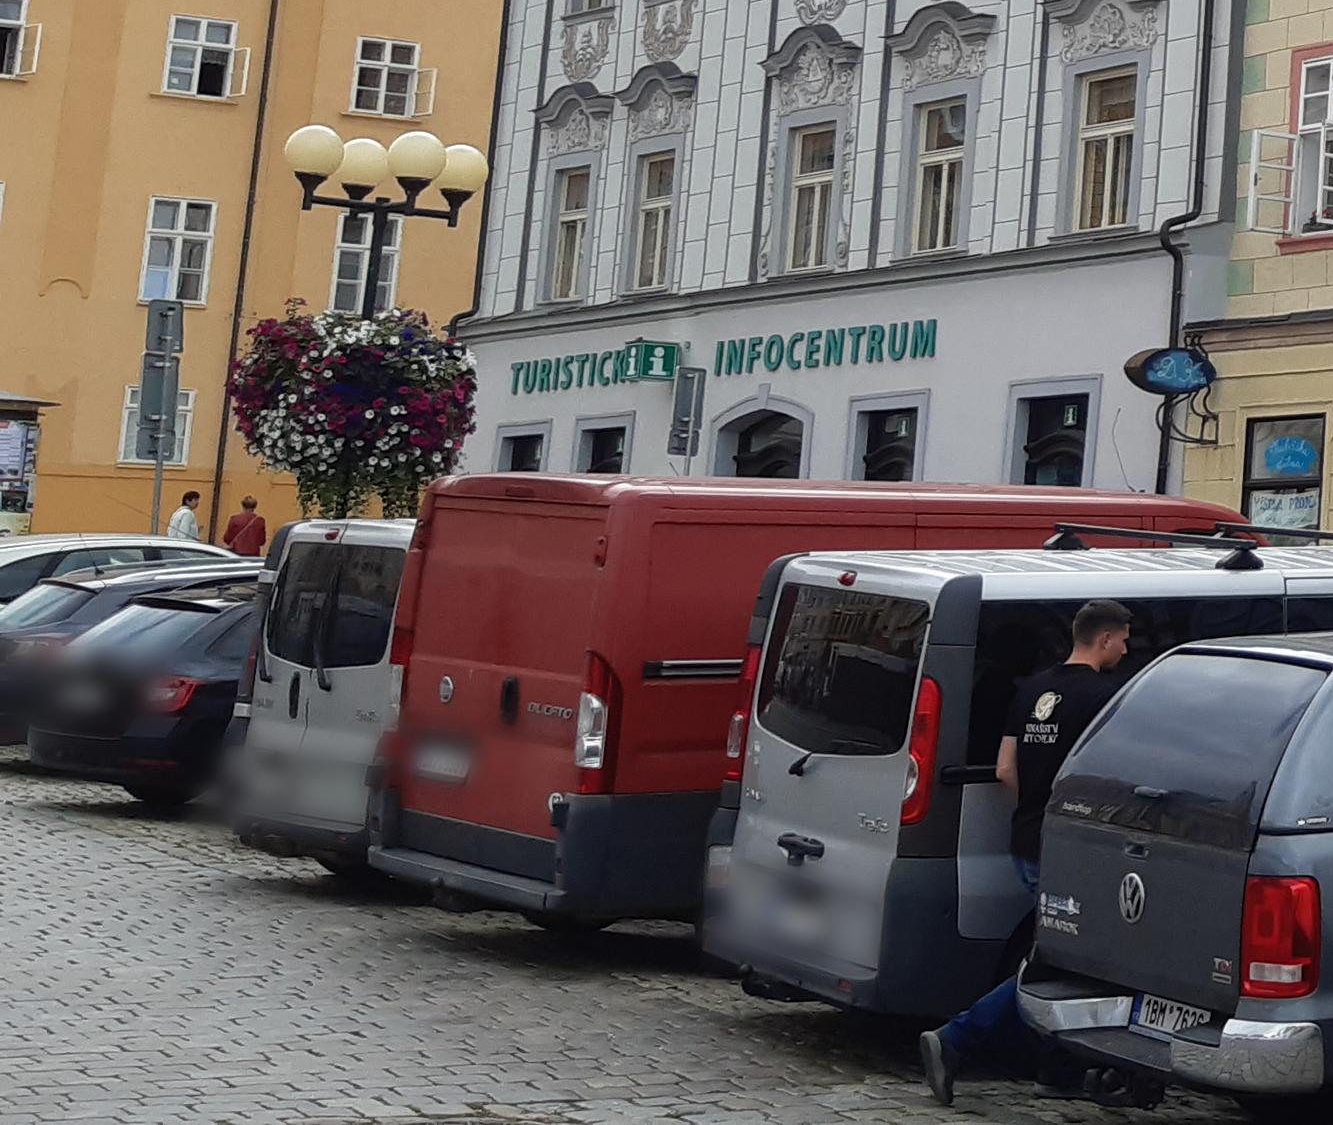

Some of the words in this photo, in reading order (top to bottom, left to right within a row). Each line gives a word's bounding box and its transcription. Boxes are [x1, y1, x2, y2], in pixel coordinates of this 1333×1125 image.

[511, 349, 640, 395] TURISTICK
[714, 319, 937, 376] INFOCENTRUM
[527, 702, 573, 719] DUCATO
[1144, 998, 1168, 1028] 1BM
